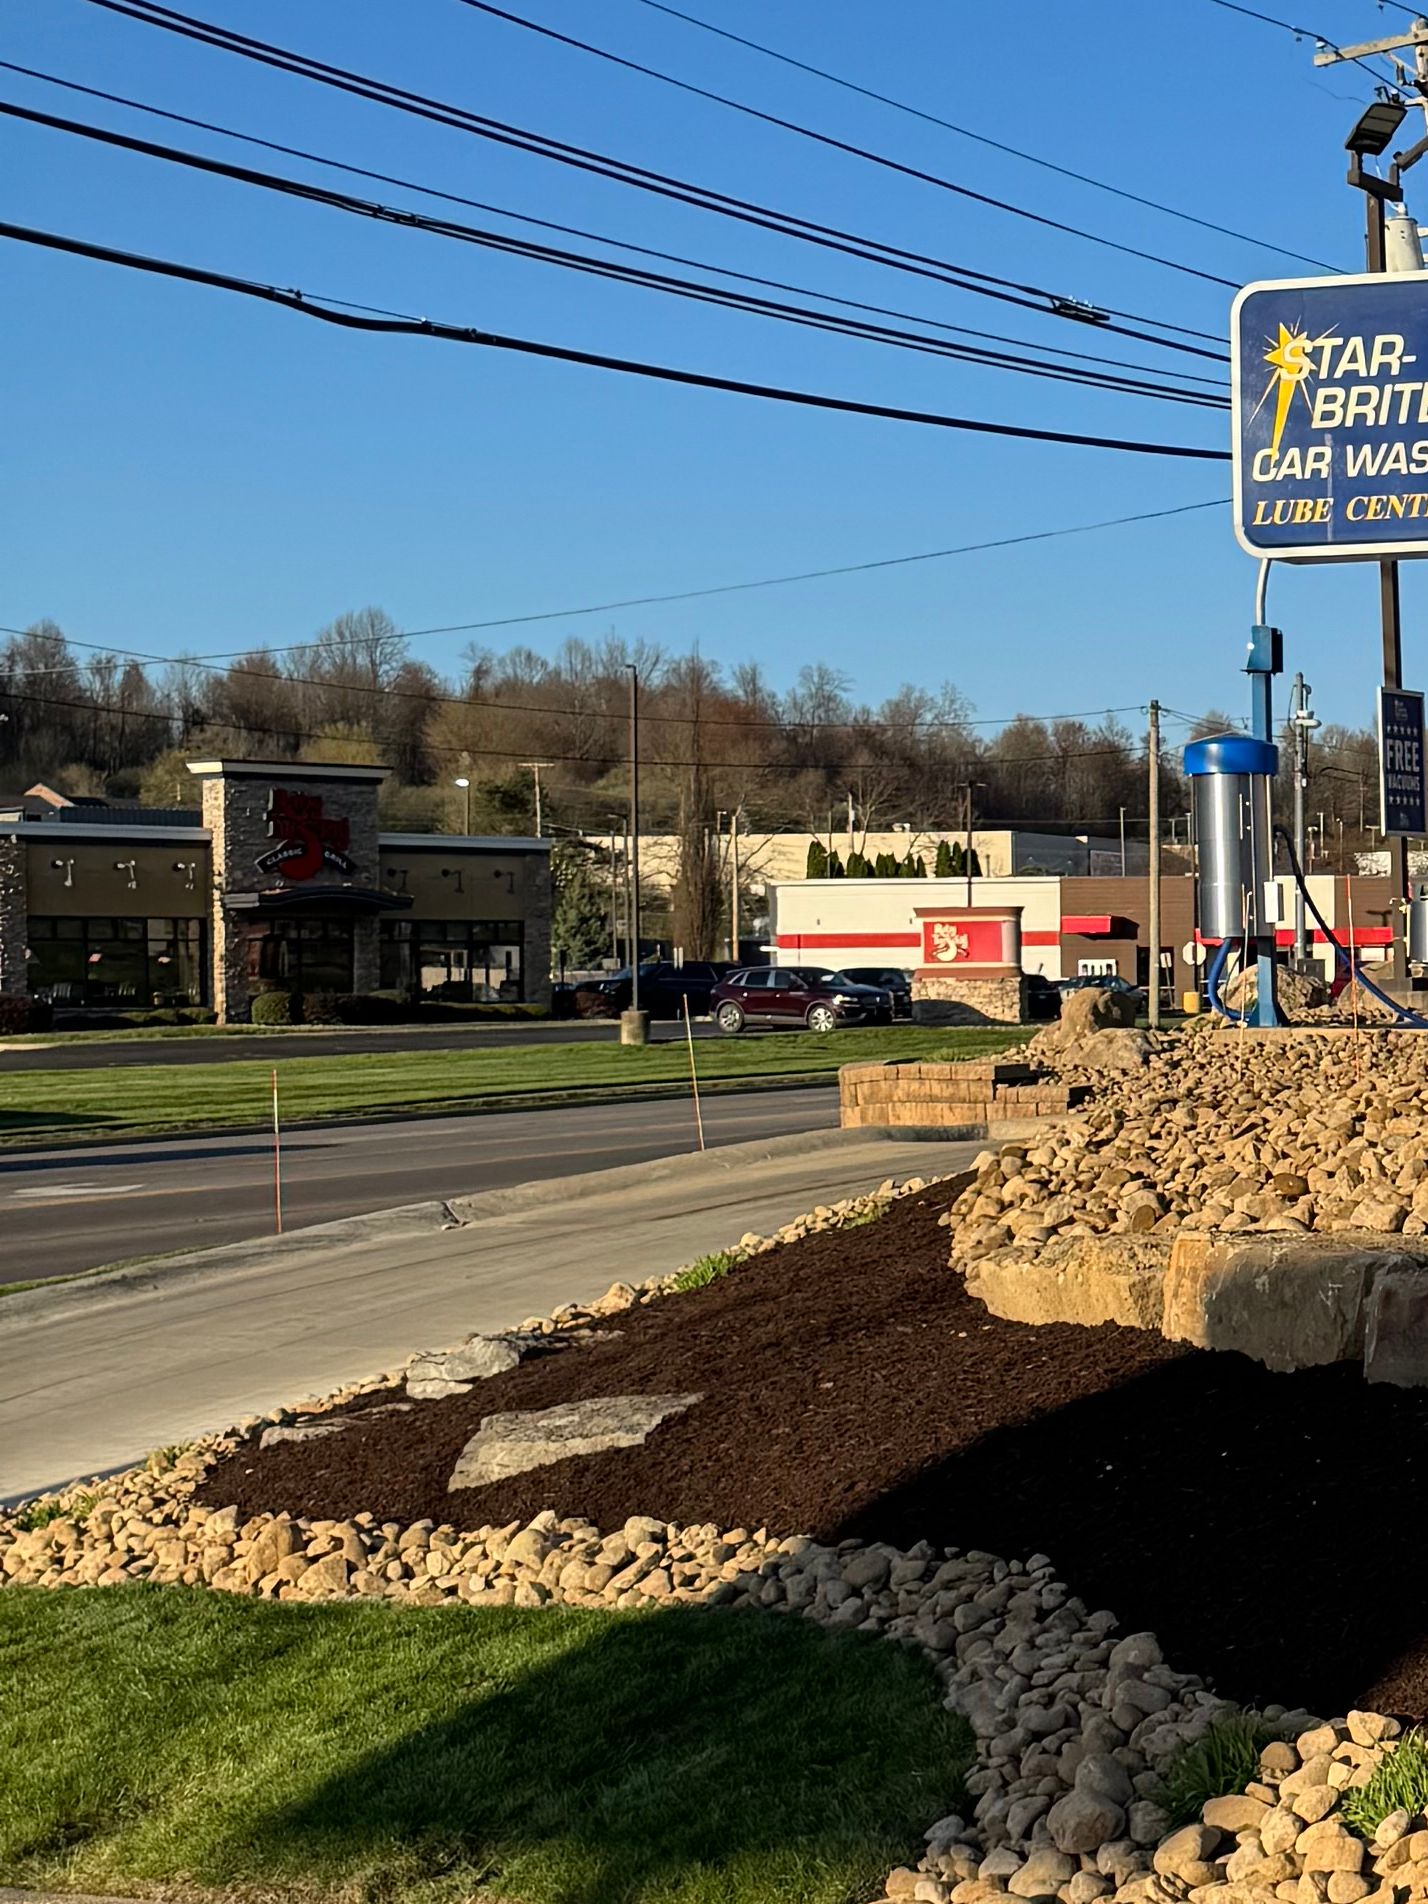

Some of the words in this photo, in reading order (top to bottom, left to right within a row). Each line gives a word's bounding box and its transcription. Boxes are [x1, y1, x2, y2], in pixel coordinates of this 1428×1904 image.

[1280, 333, 1417, 382] STAR-
[1252, 445, 1333, 482] CAR
[1252, 497, 1334, 526] LUBE
[1387, 738, 1420, 773] FREE
